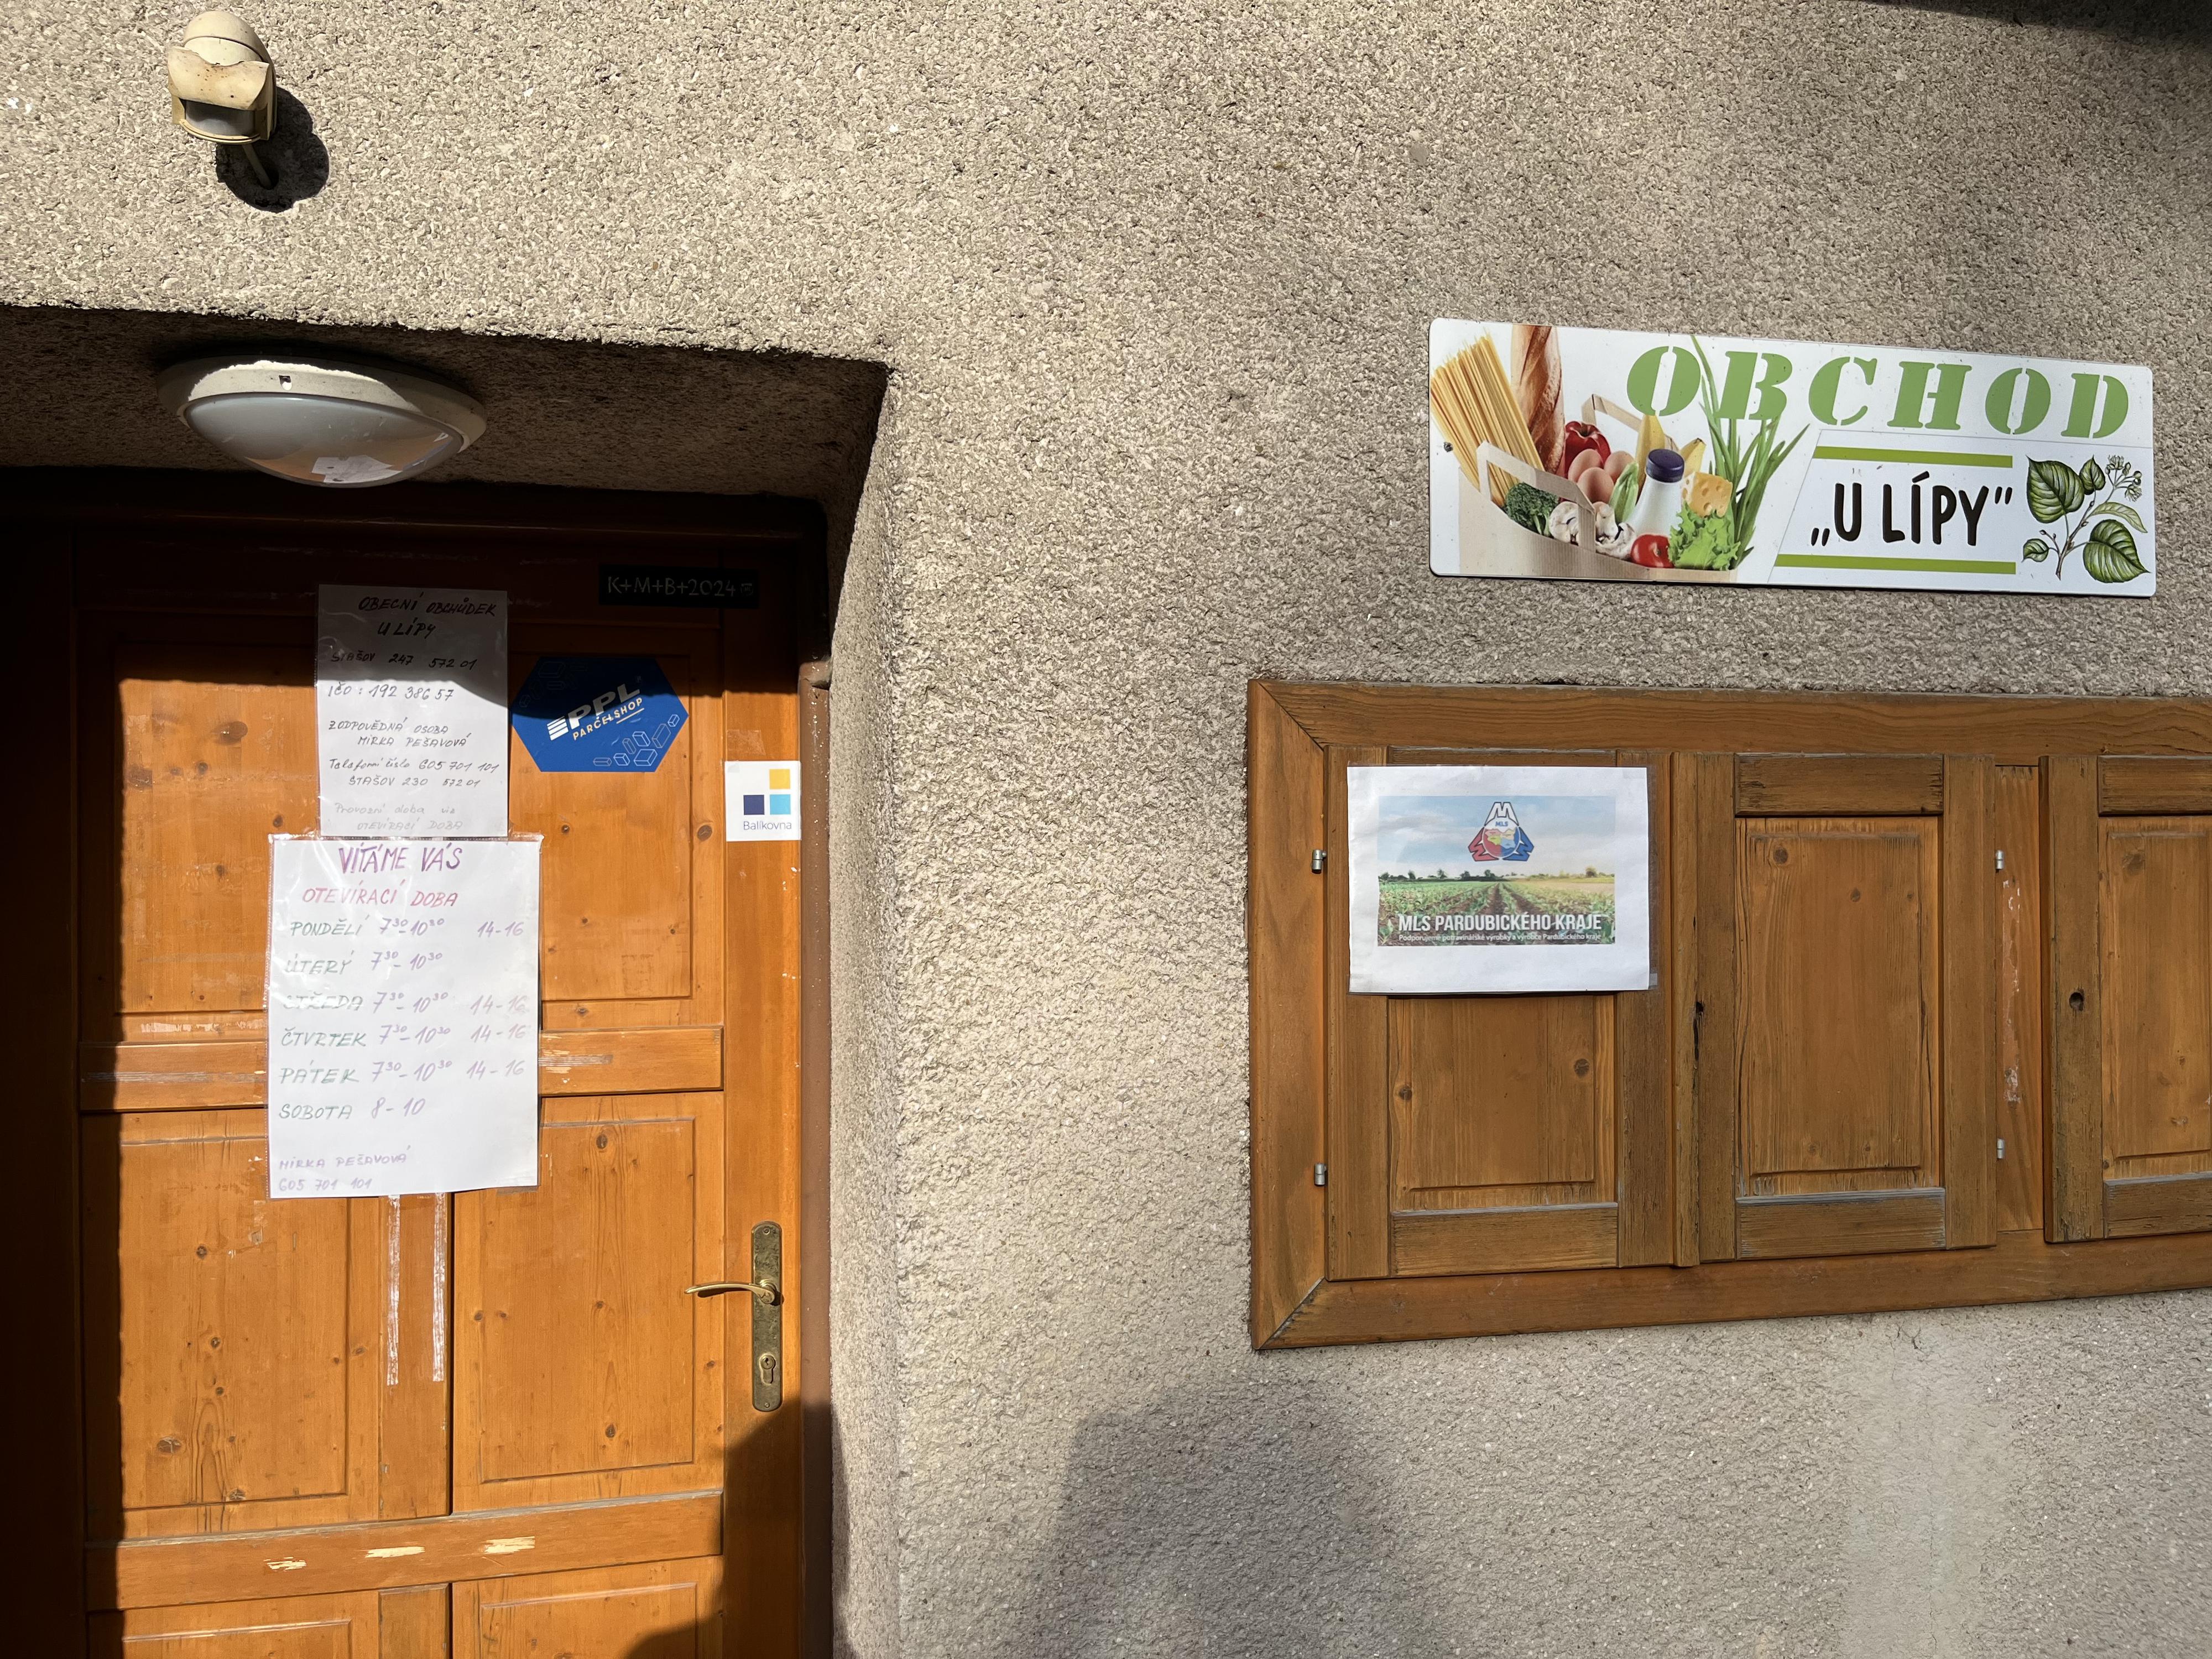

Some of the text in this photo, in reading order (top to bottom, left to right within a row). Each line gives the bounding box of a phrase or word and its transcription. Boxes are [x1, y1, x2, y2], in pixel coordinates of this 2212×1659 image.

[1627, 346, 2128, 438] OBCHOD
[359, 591, 496, 617] OBECNÍ OBCHŮDEK
[378, 617, 436, 639] U LÍPY
[389, 653, 414, 665] 247
[415, 725, 448, 734] OSOBA
[419, 759, 446, 770] 605
[448, 761, 472, 772] 701
[478, 763, 499, 774] 101
[348, 775, 395, 786] STAŠOV
[401, 777, 428, 786] 230
[394, 804, 425, 814] doba
[429, 820, 463, 830] DOBA
[744, 821, 792, 830] Balíkovna
[338, 842, 463, 874] VÍTÁME VÁS
[302, 879, 458, 908] OTEVÍRACÍ DOBA
[290, 915, 370, 937] PONDĚLÍ
[1399, 911, 1602, 931] MLS PARDUBICKÉHO KRAJE
[284, 950, 354, 974] ÚTERÝ
[281, 1027, 367, 1047] ČTVRTEK
[279, 1060, 360, 1084] PÁTEK
[279, 1103, 353, 1120] SOBOTA
[279, 1178, 372, 1192] 605 701 101
